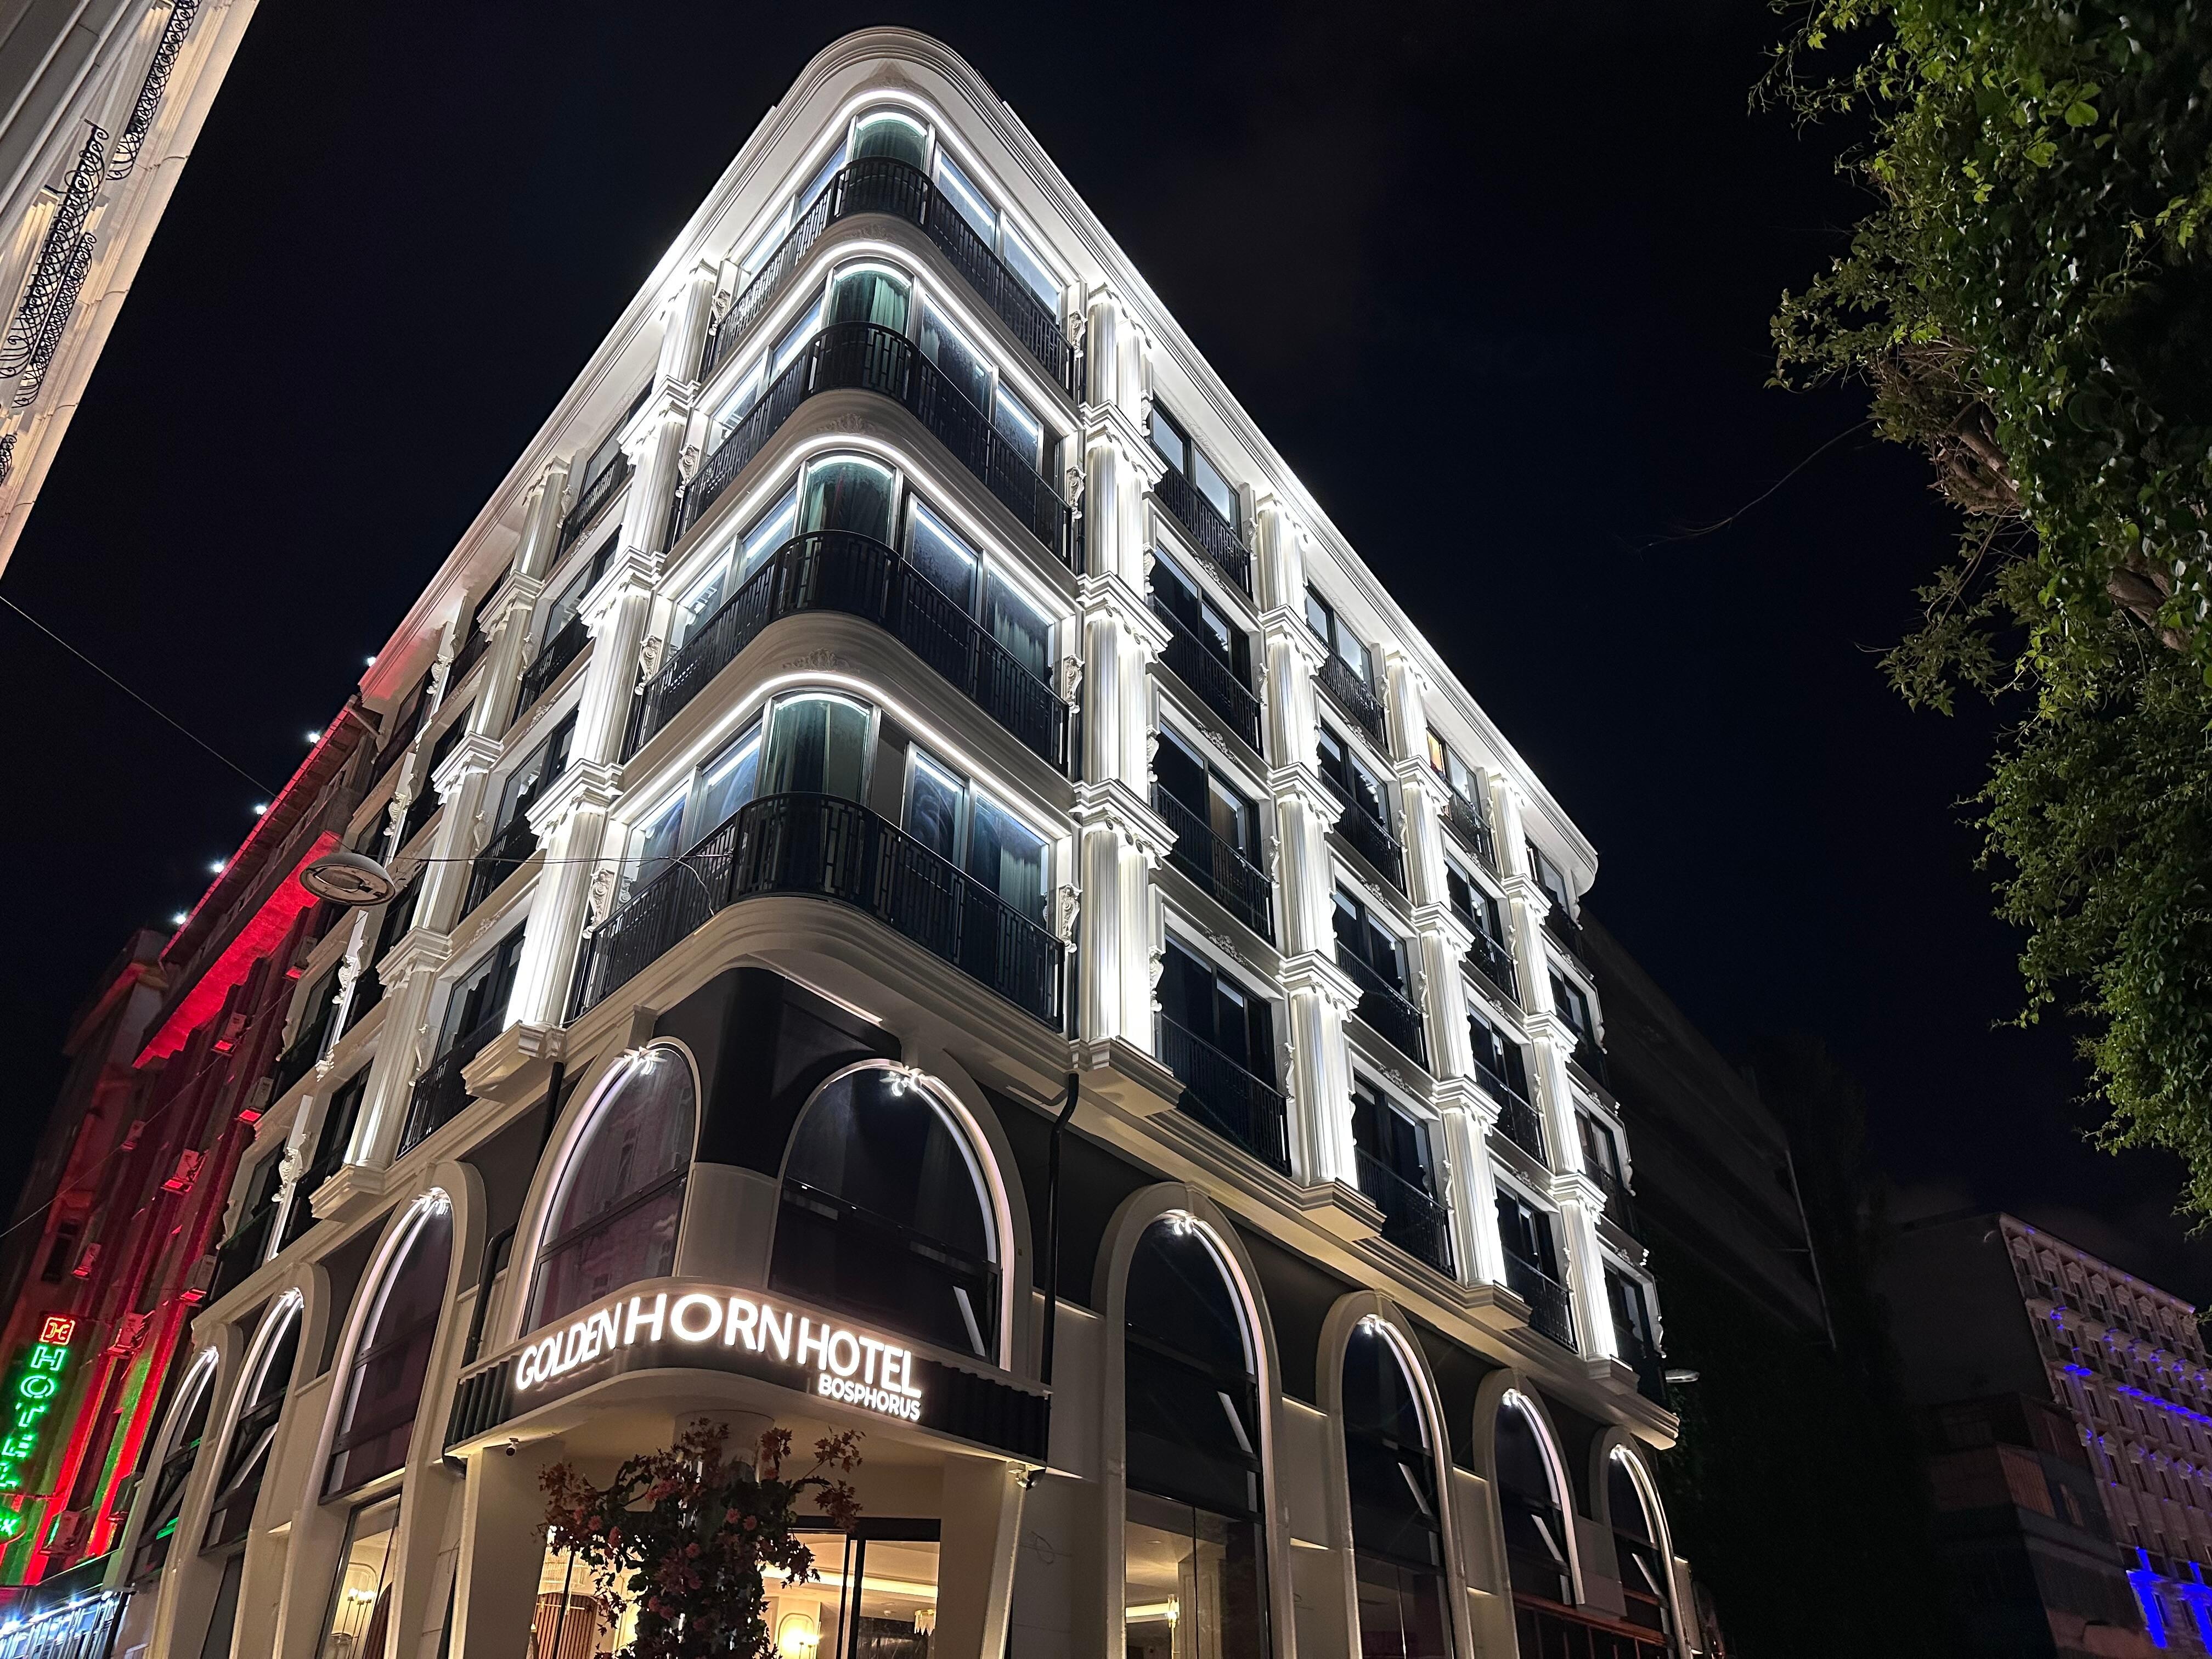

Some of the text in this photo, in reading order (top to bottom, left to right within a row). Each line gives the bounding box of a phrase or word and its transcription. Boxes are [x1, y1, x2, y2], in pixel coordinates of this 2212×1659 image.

[516, 1293, 921, 1398] GOLDEN HORN HOTEL
[818, 1373, 921, 1421] BOSPHORUS
